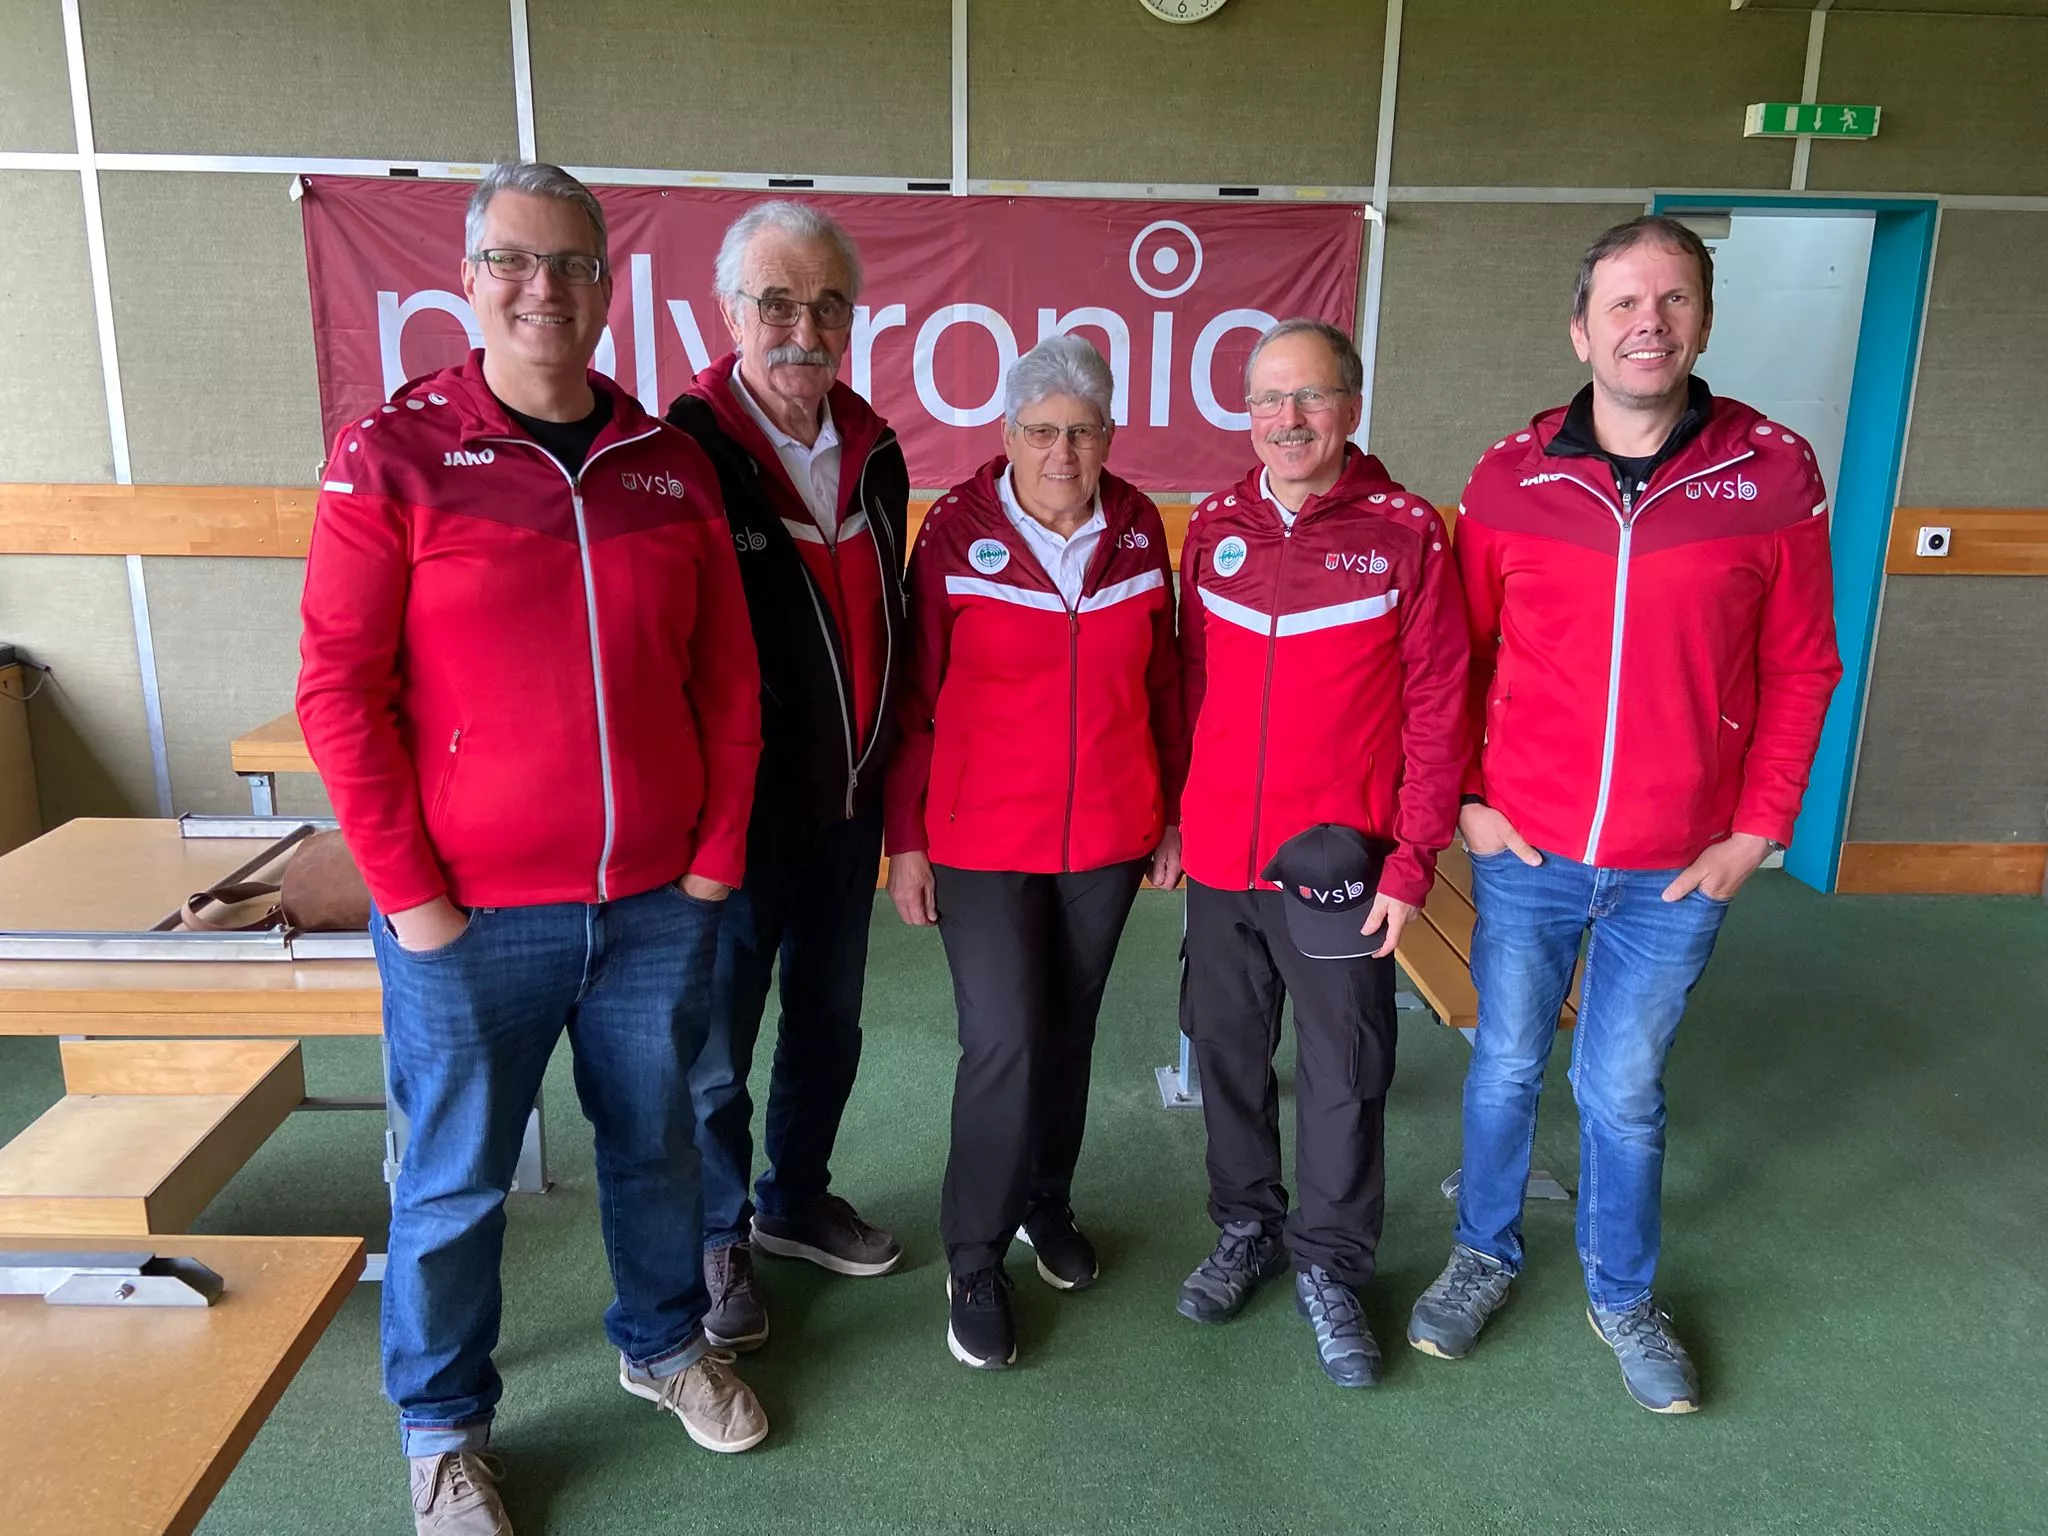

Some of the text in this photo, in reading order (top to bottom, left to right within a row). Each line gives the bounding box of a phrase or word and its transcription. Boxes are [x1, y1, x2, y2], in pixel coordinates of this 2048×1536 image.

[443, 448, 495, 466] JAKO
[636, 470, 684, 499] vsb
[1702, 473, 1758, 501] vsb
[731, 526, 767, 551] sb
[1341, 549, 1388, 574] vsb
[1313, 880, 1364, 904] vsb
